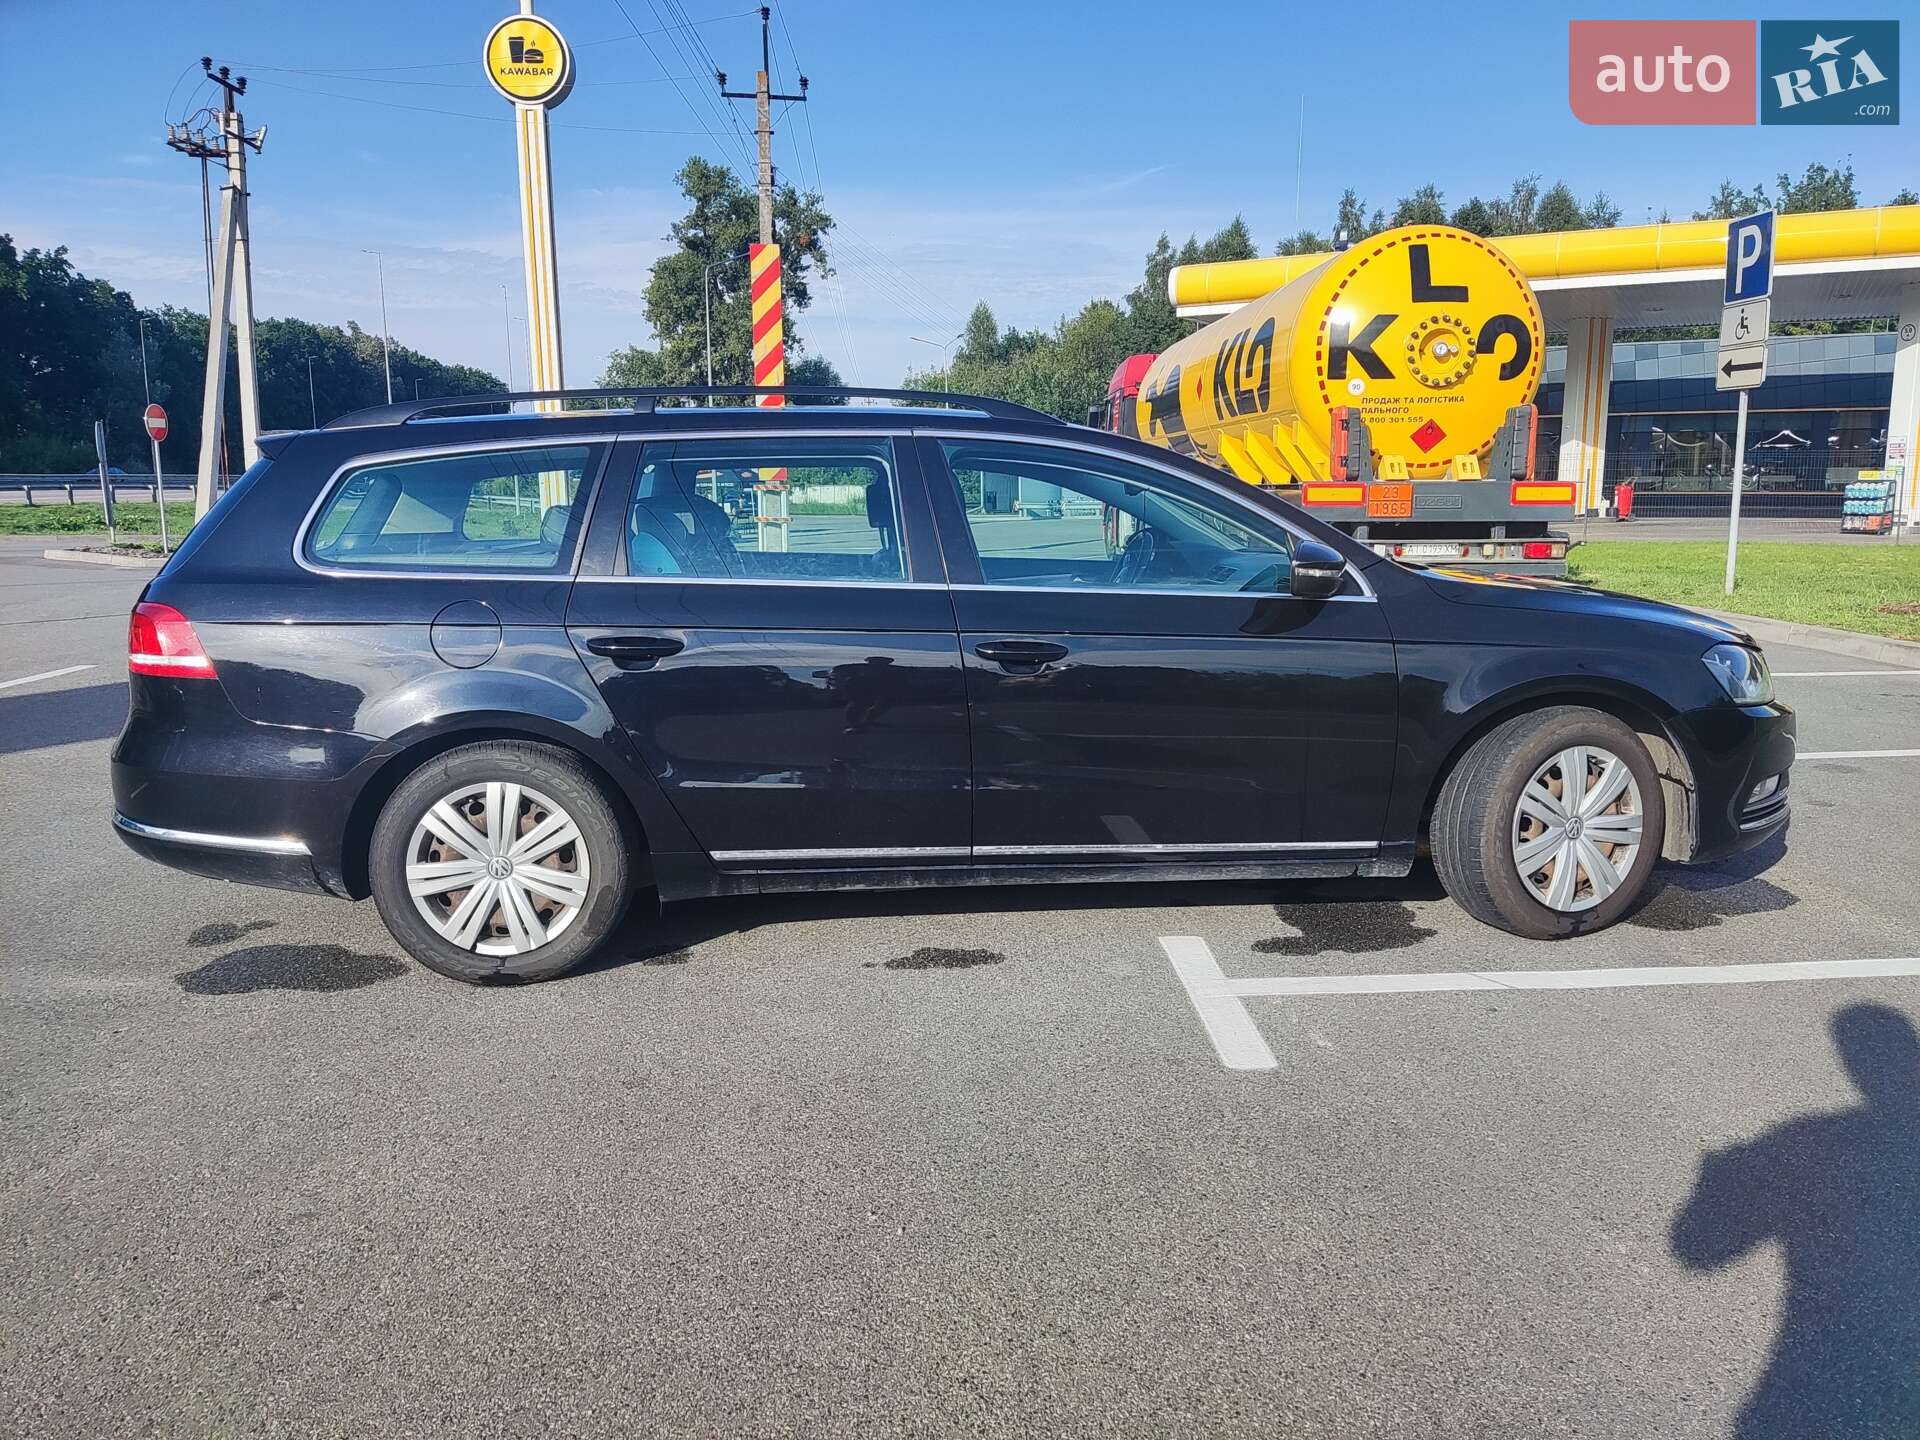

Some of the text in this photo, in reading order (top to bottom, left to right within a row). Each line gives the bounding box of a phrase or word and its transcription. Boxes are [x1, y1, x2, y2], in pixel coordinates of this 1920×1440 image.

[500, 67, 554, 76] KAWABAR
[1735, 225, 1762, 294] P
[1361, 395, 1465, 405] ПРОДАЖ ТА ЛОГІСТИКА
[1383, 487, 1399, 498] 23
[1374, 503, 1407, 515] 1965
